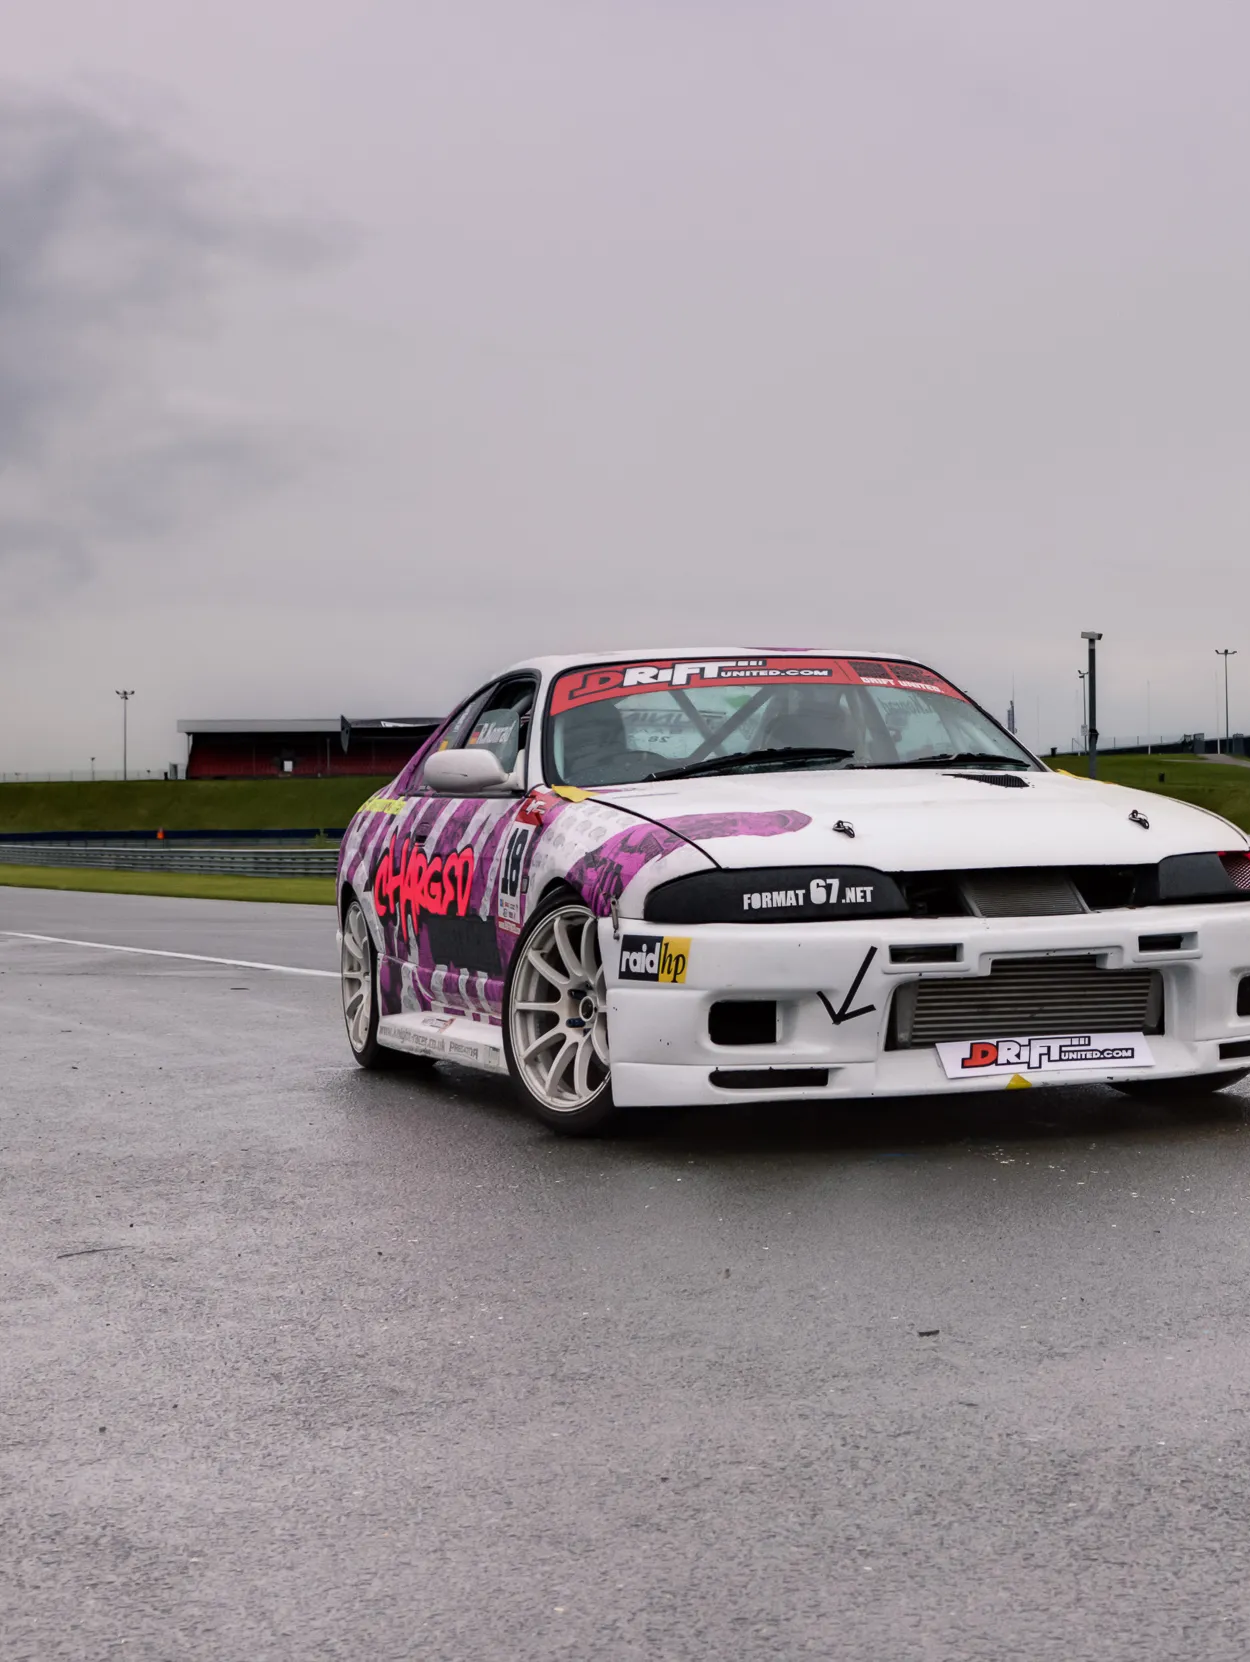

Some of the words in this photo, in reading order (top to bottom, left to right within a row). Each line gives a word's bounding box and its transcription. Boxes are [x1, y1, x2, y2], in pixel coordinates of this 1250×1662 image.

[720, 669, 829, 677] UNITED.COM
[860, 676, 895, 686] DRIFT
[743, 889, 805, 910] FORMAT
[810, 878, 839, 904] 67
[842, 886, 873, 903] .NET
[1060, 1049, 1134, 1060] UNITED.COM
